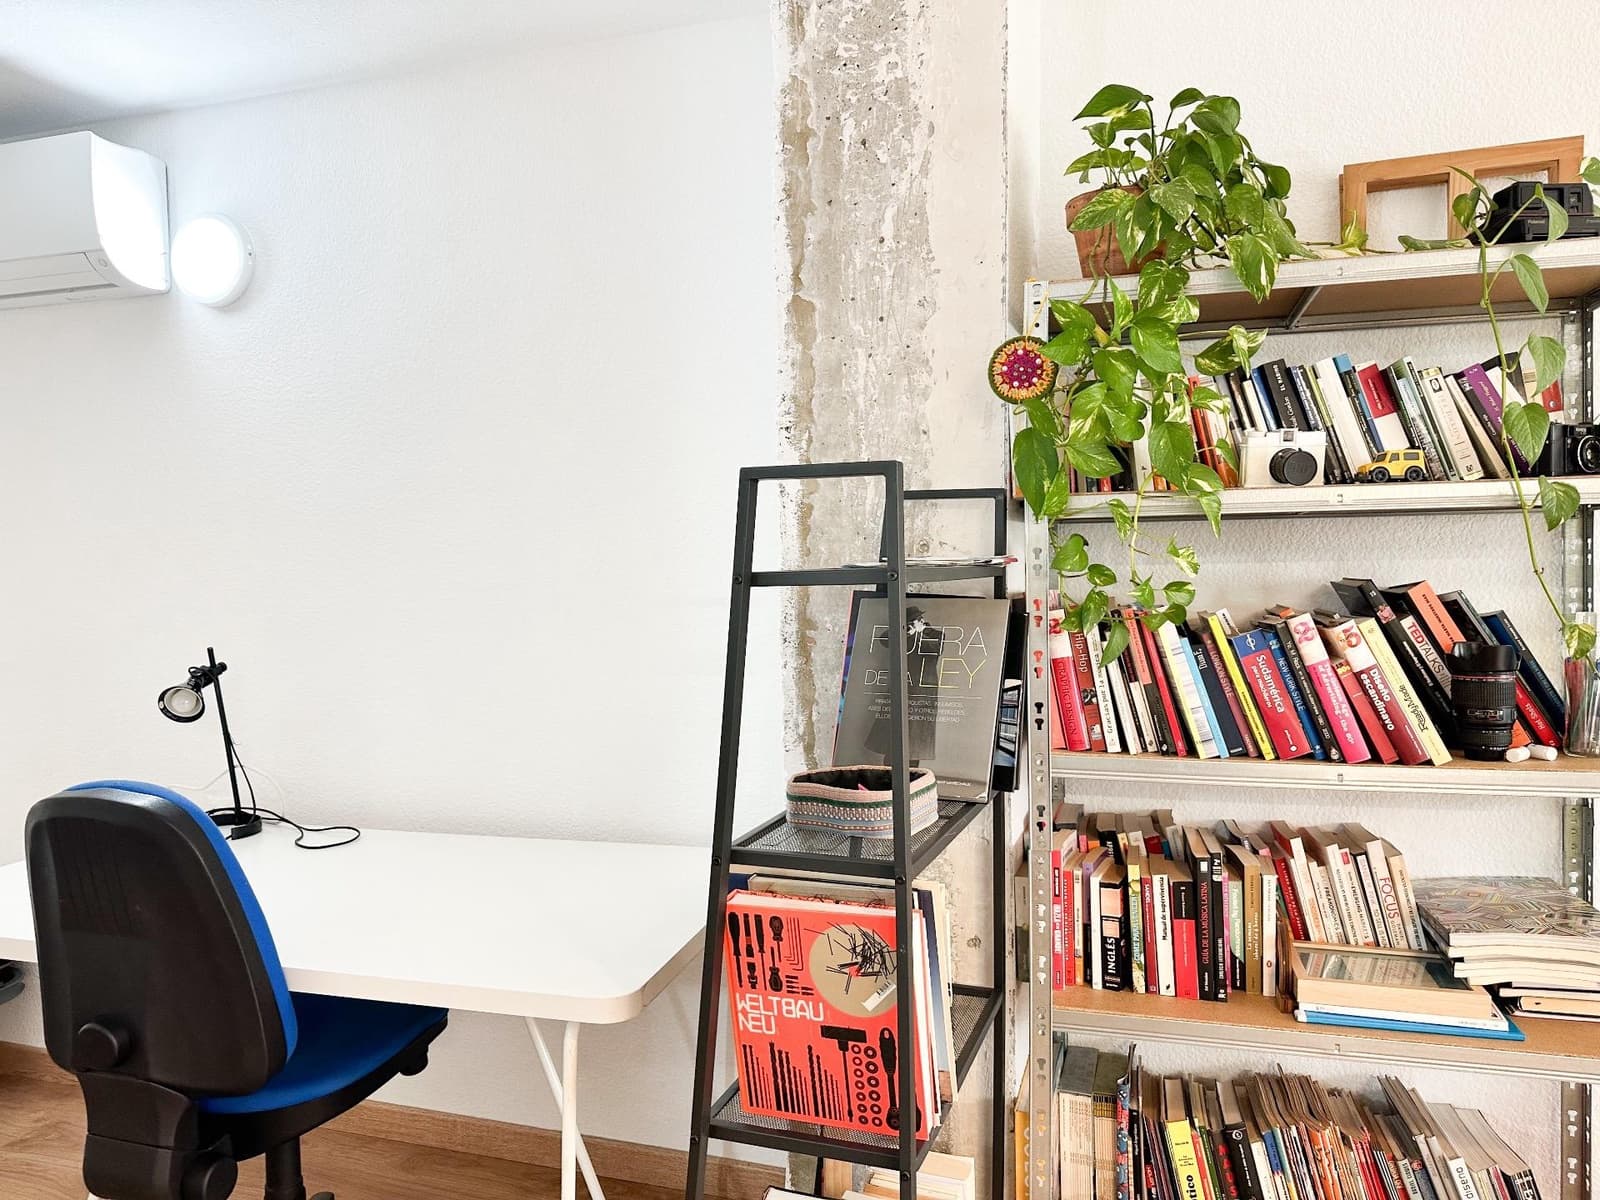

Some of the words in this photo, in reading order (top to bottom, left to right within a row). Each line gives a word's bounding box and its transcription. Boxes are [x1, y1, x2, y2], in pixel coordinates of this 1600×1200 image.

[1072, 632, 1089, 672] Hip-Hop
[919, 658, 986, 688] LEY
[1052, 660, 1073, 701] GRAPHIC
[1253, 653, 1289, 713] Sudamérica
[1368, 667, 1393, 702] Diseño
[1061, 701, 1080, 736] DESIGN
[1102, 703, 1113, 734] Gracias
[1357, 672, 1397, 732] escandinavo
[1158, 876, 1166, 912] supervivencia
[1377, 876, 1401, 920] FOCUS
[1200, 905, 1208, 928] MÚSICA
[1105, 937, 1115, 973] INGLÉS
[736, 992, 824, 1022] WELTBAU
[739, 1013, 776, 1035] NEU
[1186, 1174, 1197, 1200] tico
